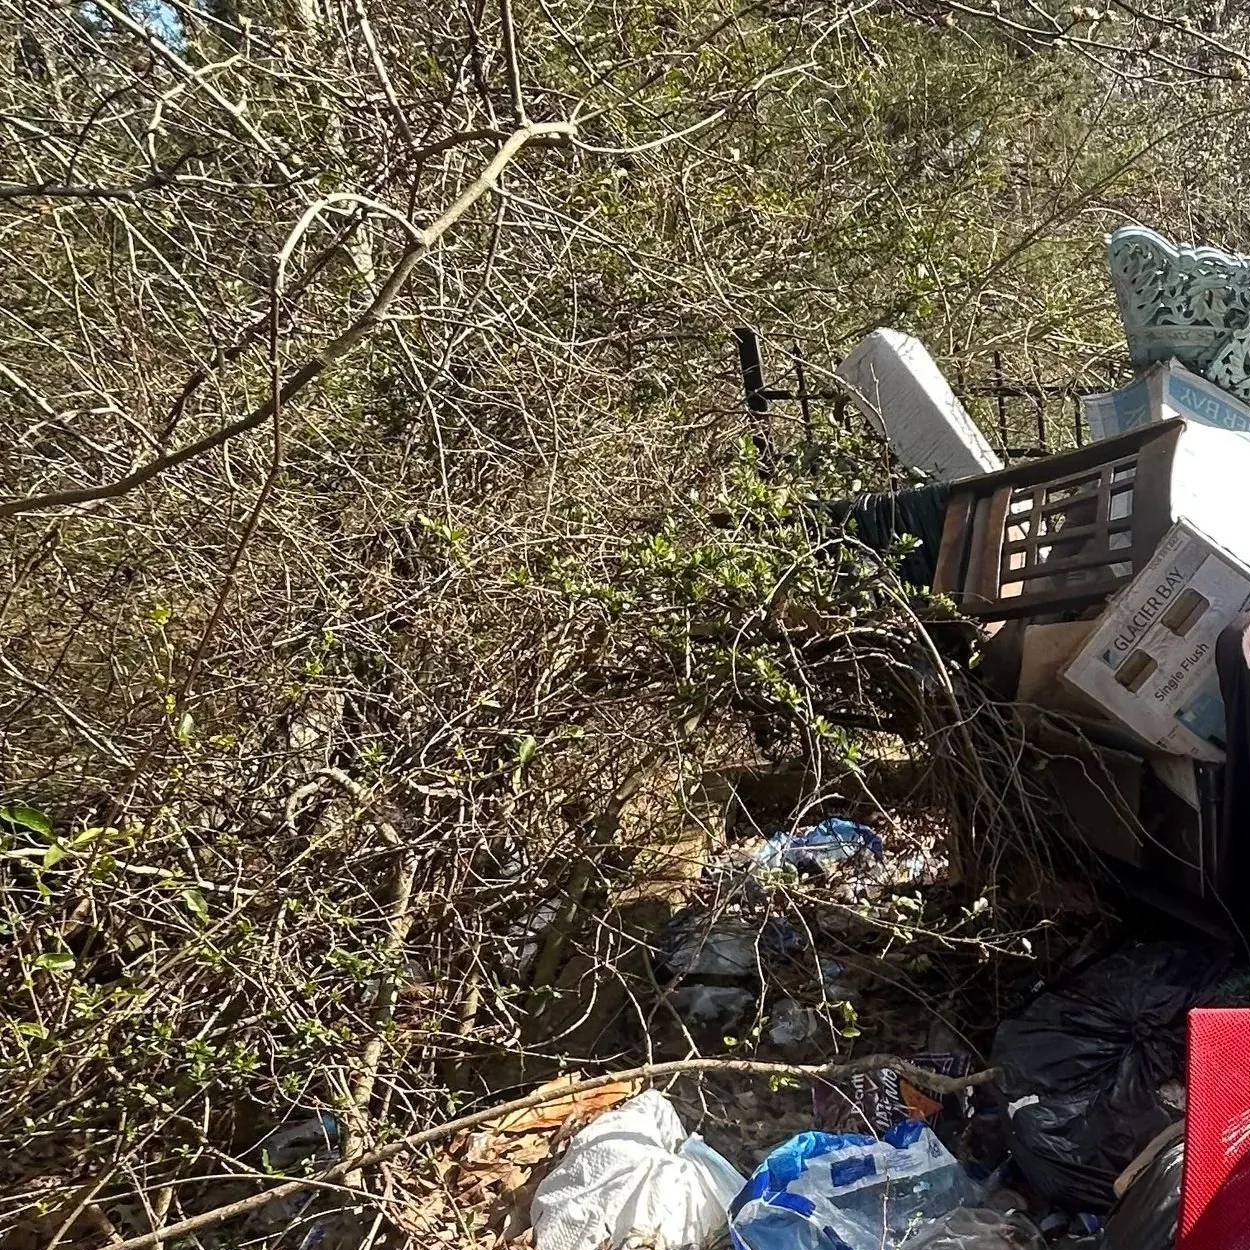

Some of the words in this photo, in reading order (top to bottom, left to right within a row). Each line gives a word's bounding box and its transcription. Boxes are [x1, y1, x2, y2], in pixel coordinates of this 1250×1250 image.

[1179, 387, 1220, 420] BAY
[1113, 596, 1166, 653] GLACIER
[1156, 566, 1187, 602] BAY
[1153, 669, 1185, 702] Single
[1182, 642, 1211, 674] Flush
